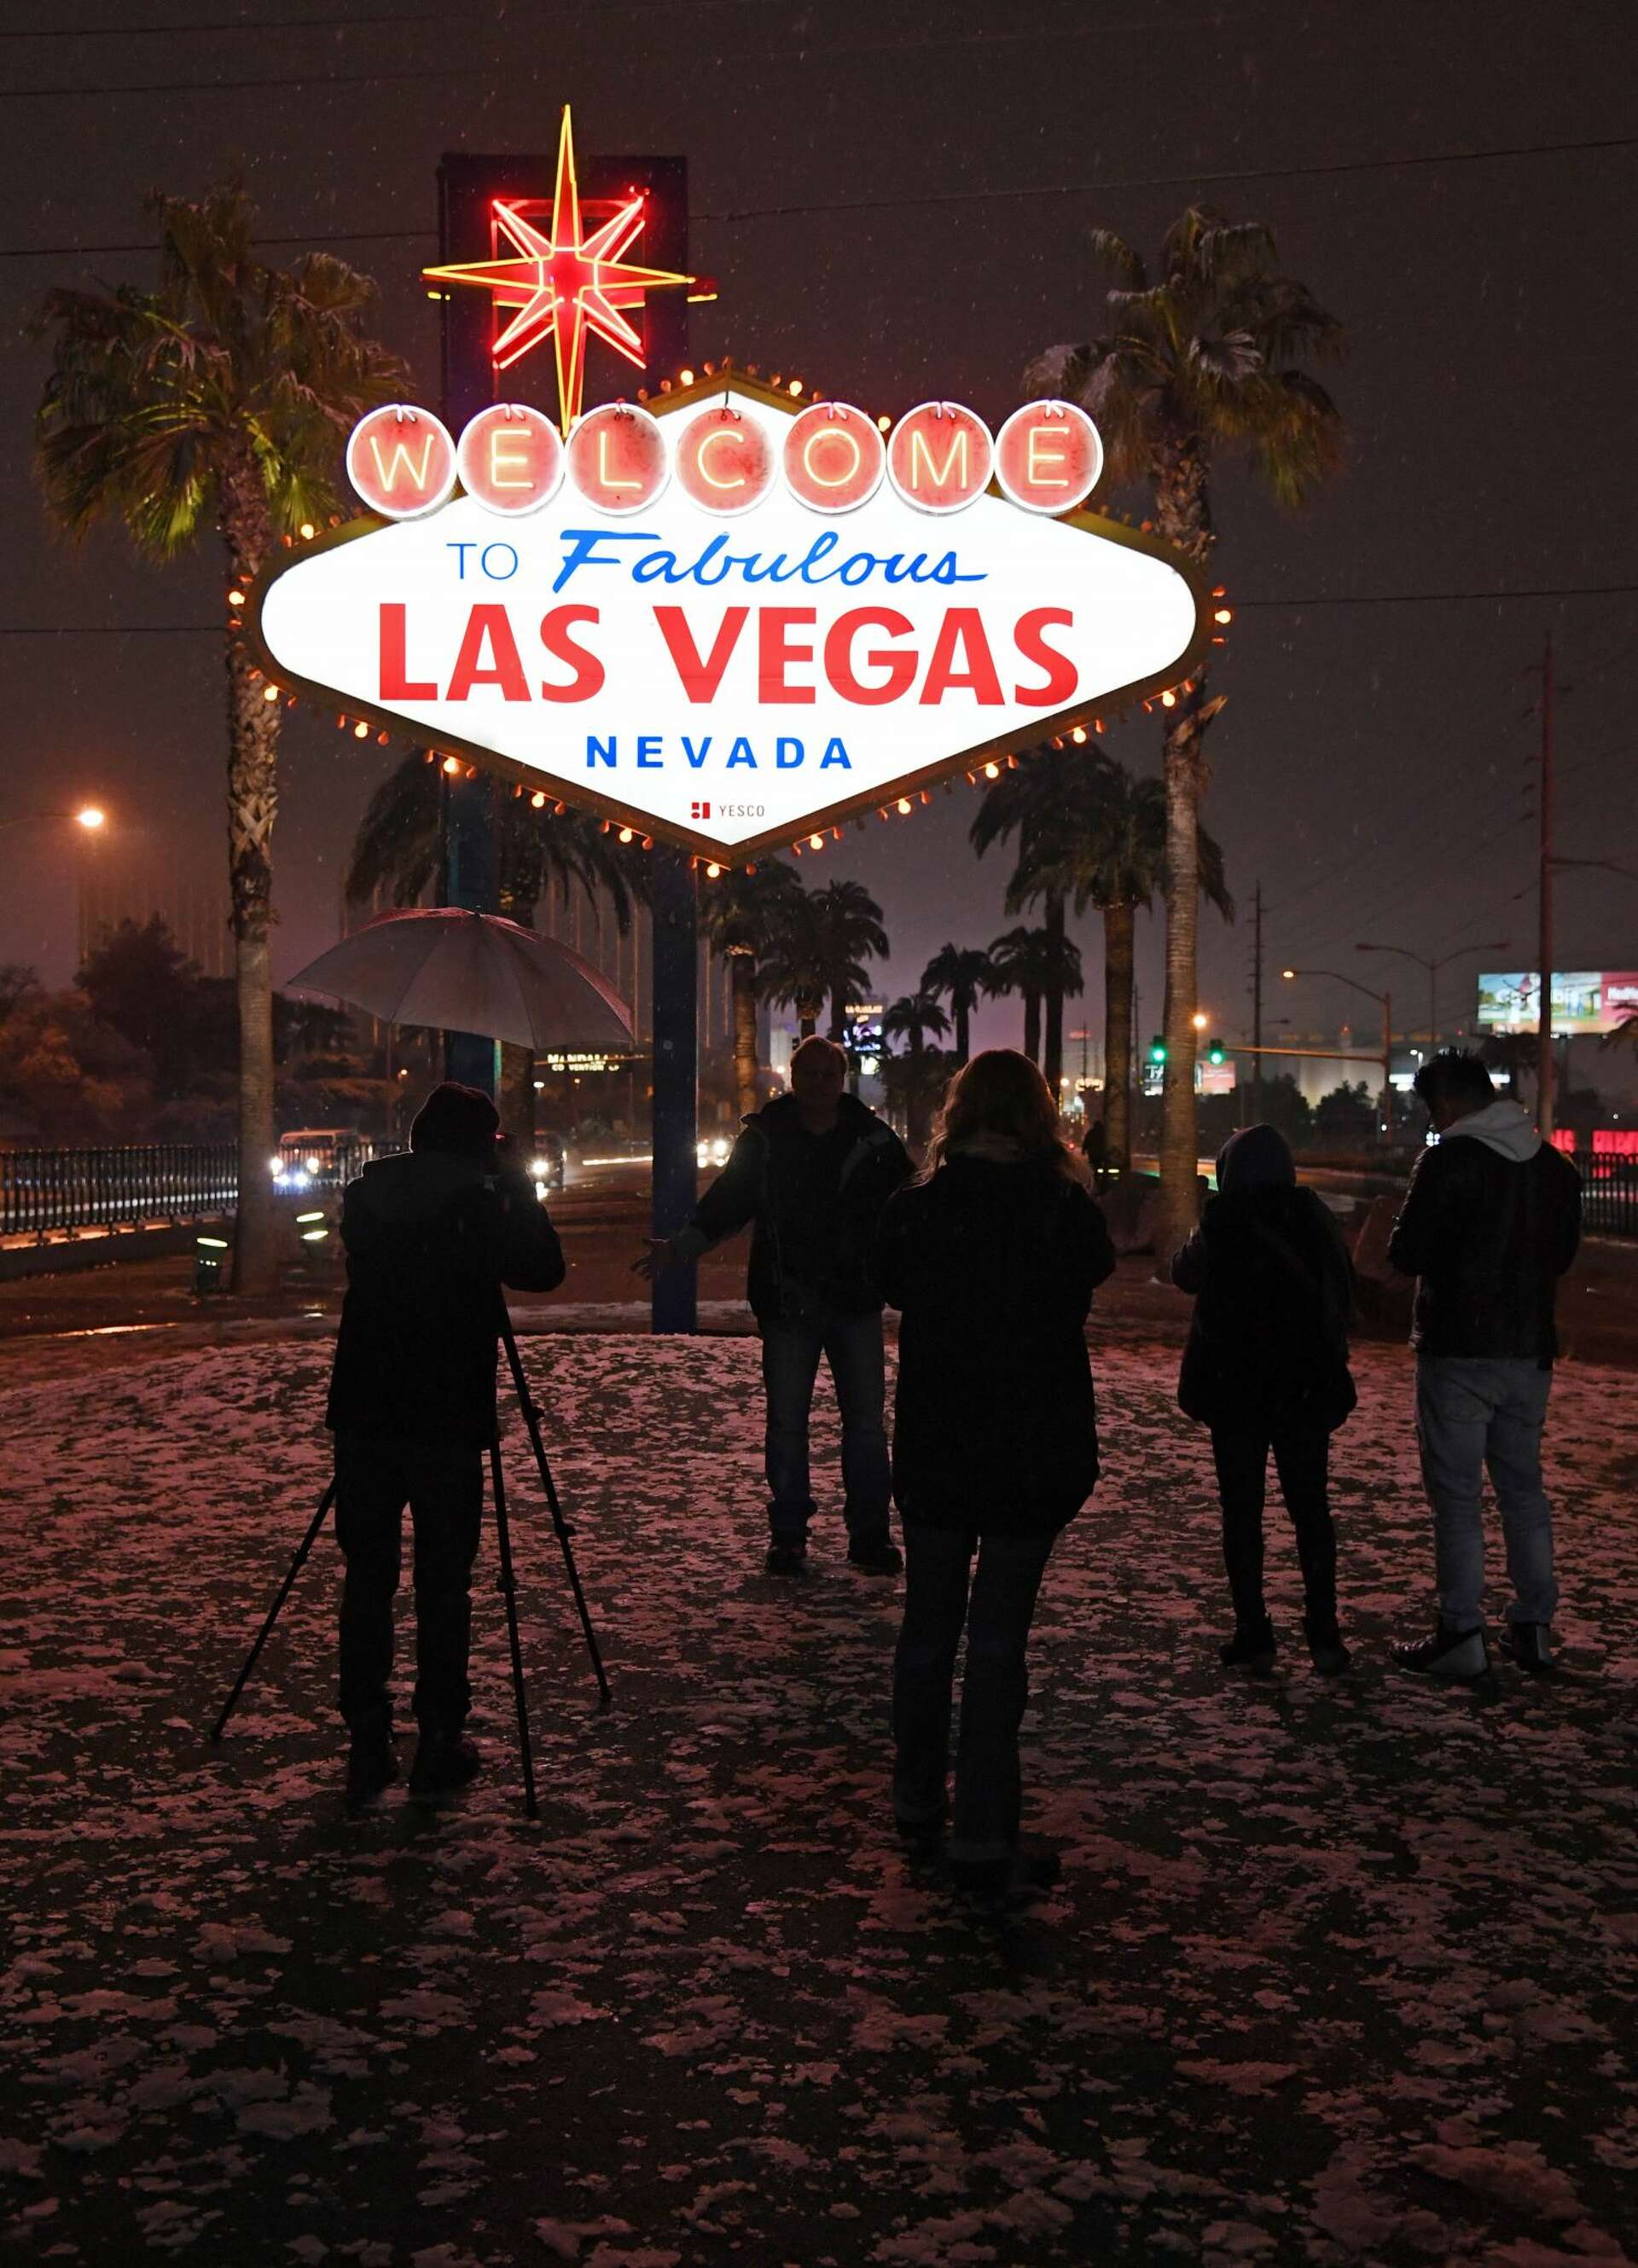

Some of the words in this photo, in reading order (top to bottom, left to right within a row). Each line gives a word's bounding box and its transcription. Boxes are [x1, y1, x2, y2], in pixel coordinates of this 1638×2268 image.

[370, 427, 1071, 492] WELCOME
[447, 542, 519, 580] TO
[552, 529, 988, 595] Fabulous
[379, 603, 605, 704] LAS
[653, 606, 1079, 707] VEGAS
[586, 735, 852, 769] NEVADA
[718, 804, 765, 817] YESCO
